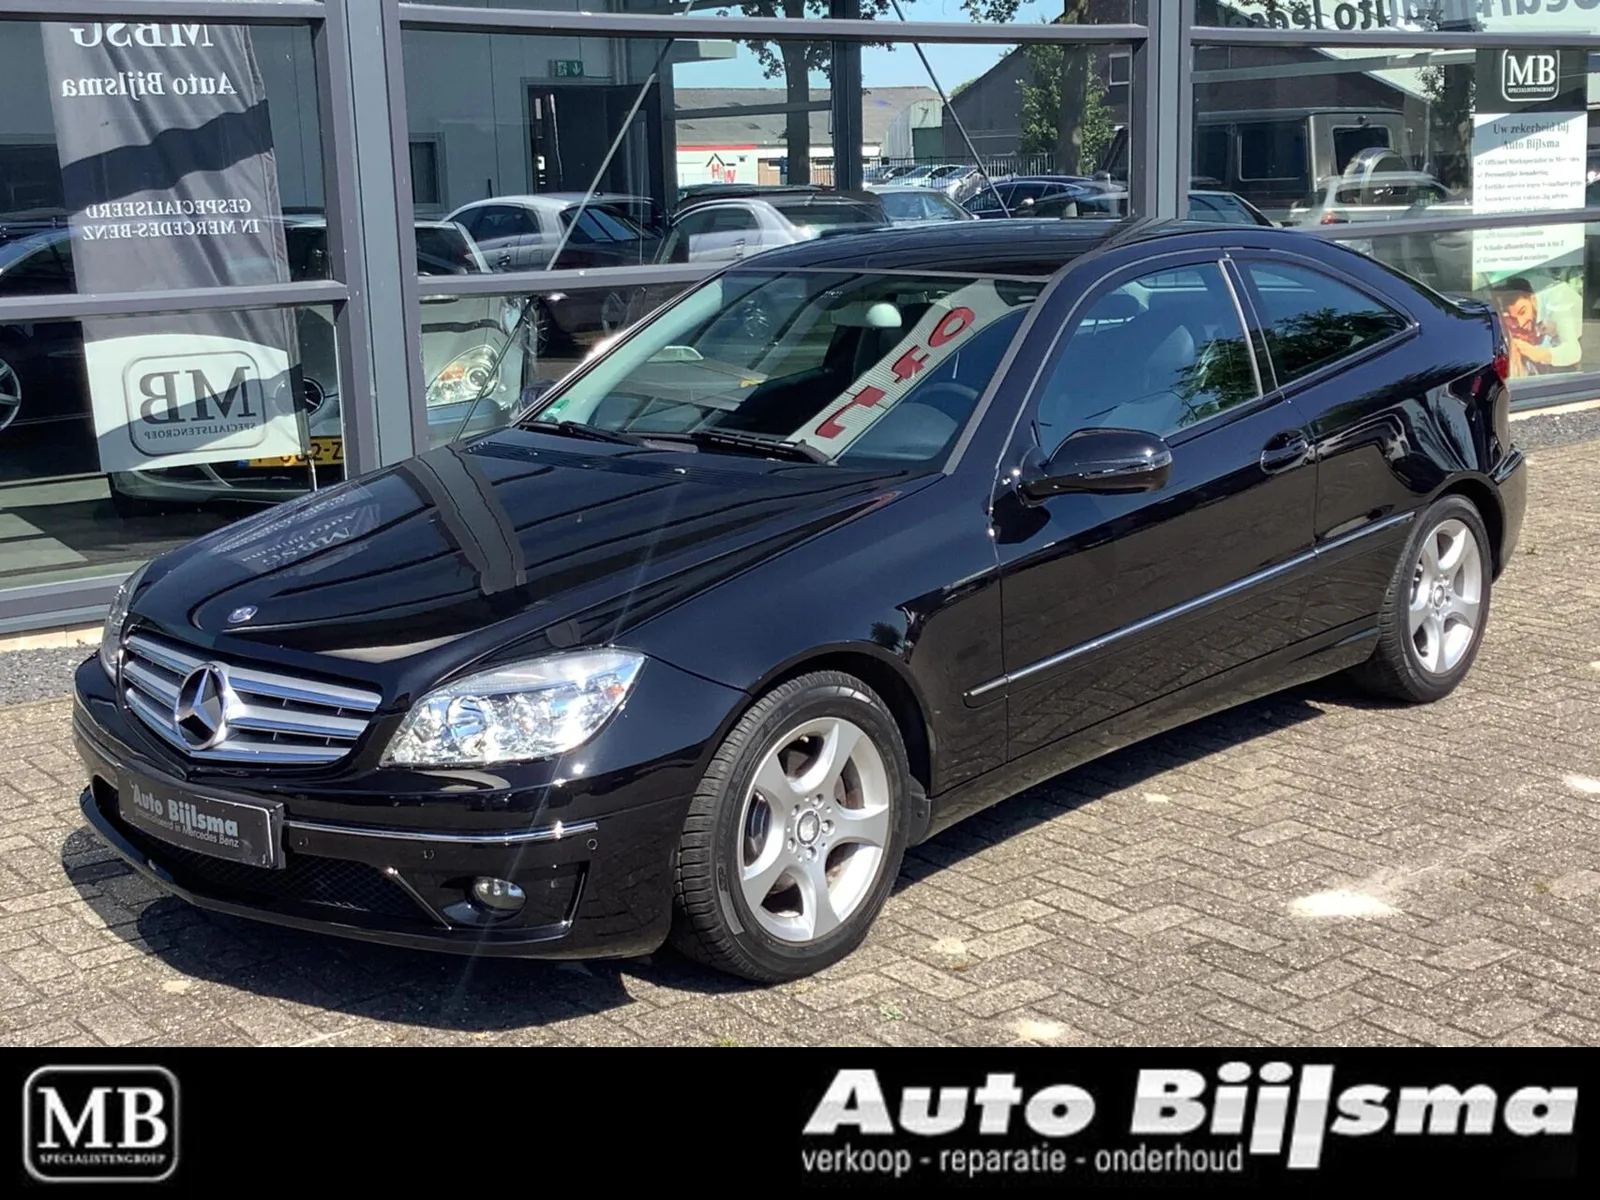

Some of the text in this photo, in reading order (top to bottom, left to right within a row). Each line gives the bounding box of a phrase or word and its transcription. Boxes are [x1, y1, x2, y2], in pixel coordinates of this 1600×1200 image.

[1507, 55, 1555, 86] MB
[1494, 124, 1509, 134] Uw
[1510, 121, 1555, 133] zekerheid
[1503, 139, 1560, 150] Auto Bijlsma
[133, 784, 239, 837] Auto Bijlsma
